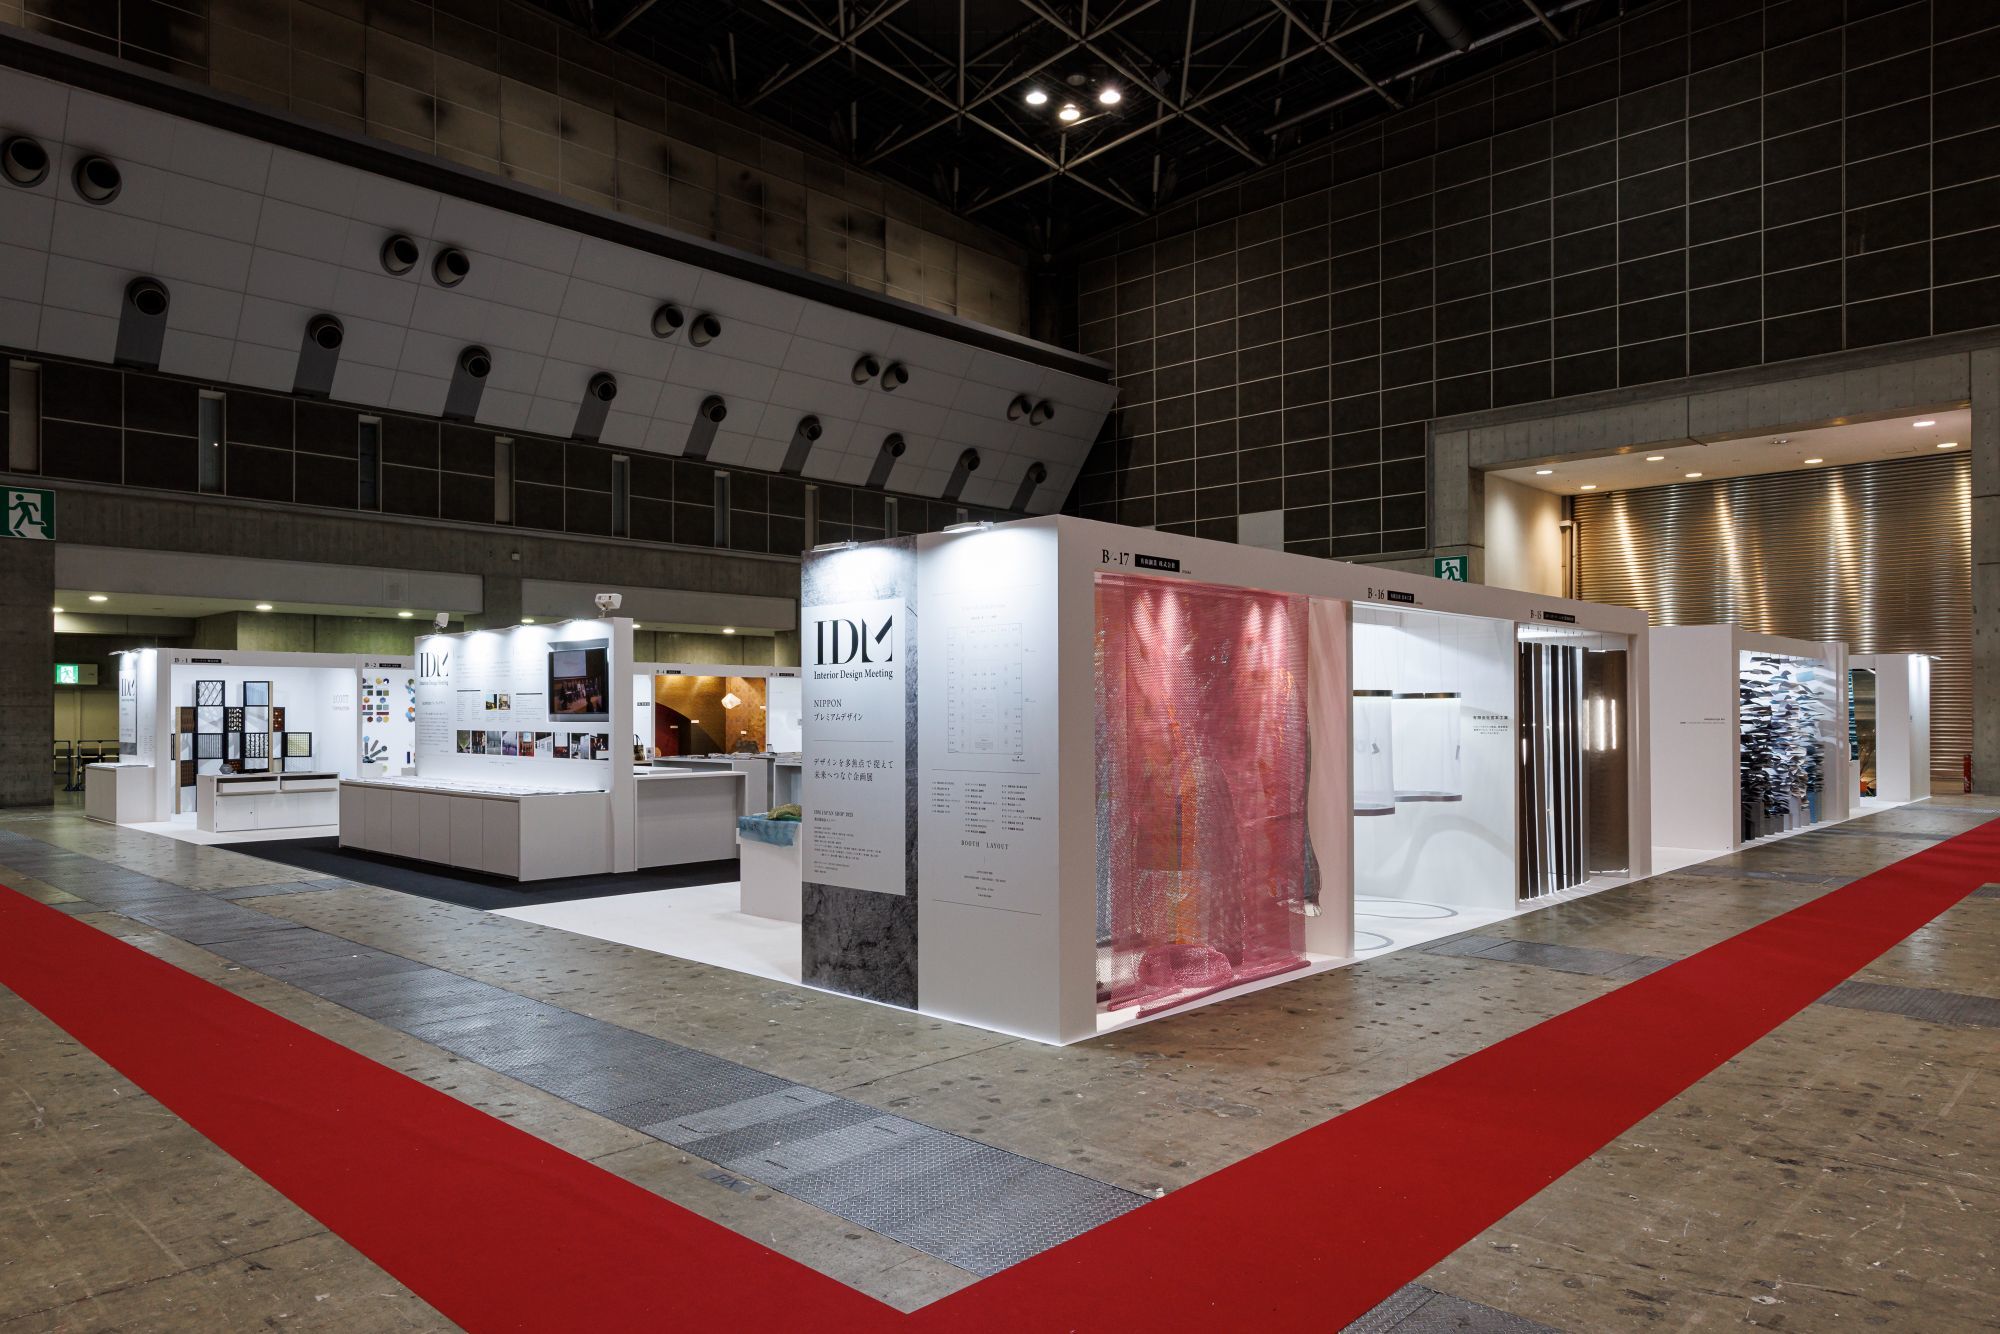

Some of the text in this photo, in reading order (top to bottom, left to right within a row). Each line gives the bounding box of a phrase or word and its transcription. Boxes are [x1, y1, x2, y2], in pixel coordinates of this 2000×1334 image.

[814, 614, 893, 666] IDM
[814, 668, 893, 682] Interior Design Meeting
[814, 699, 842, 708] NIPPON
[814, 712, 864, 721] プレミアムデザイン
[986, 842, 1009, 850] LAYOUT
